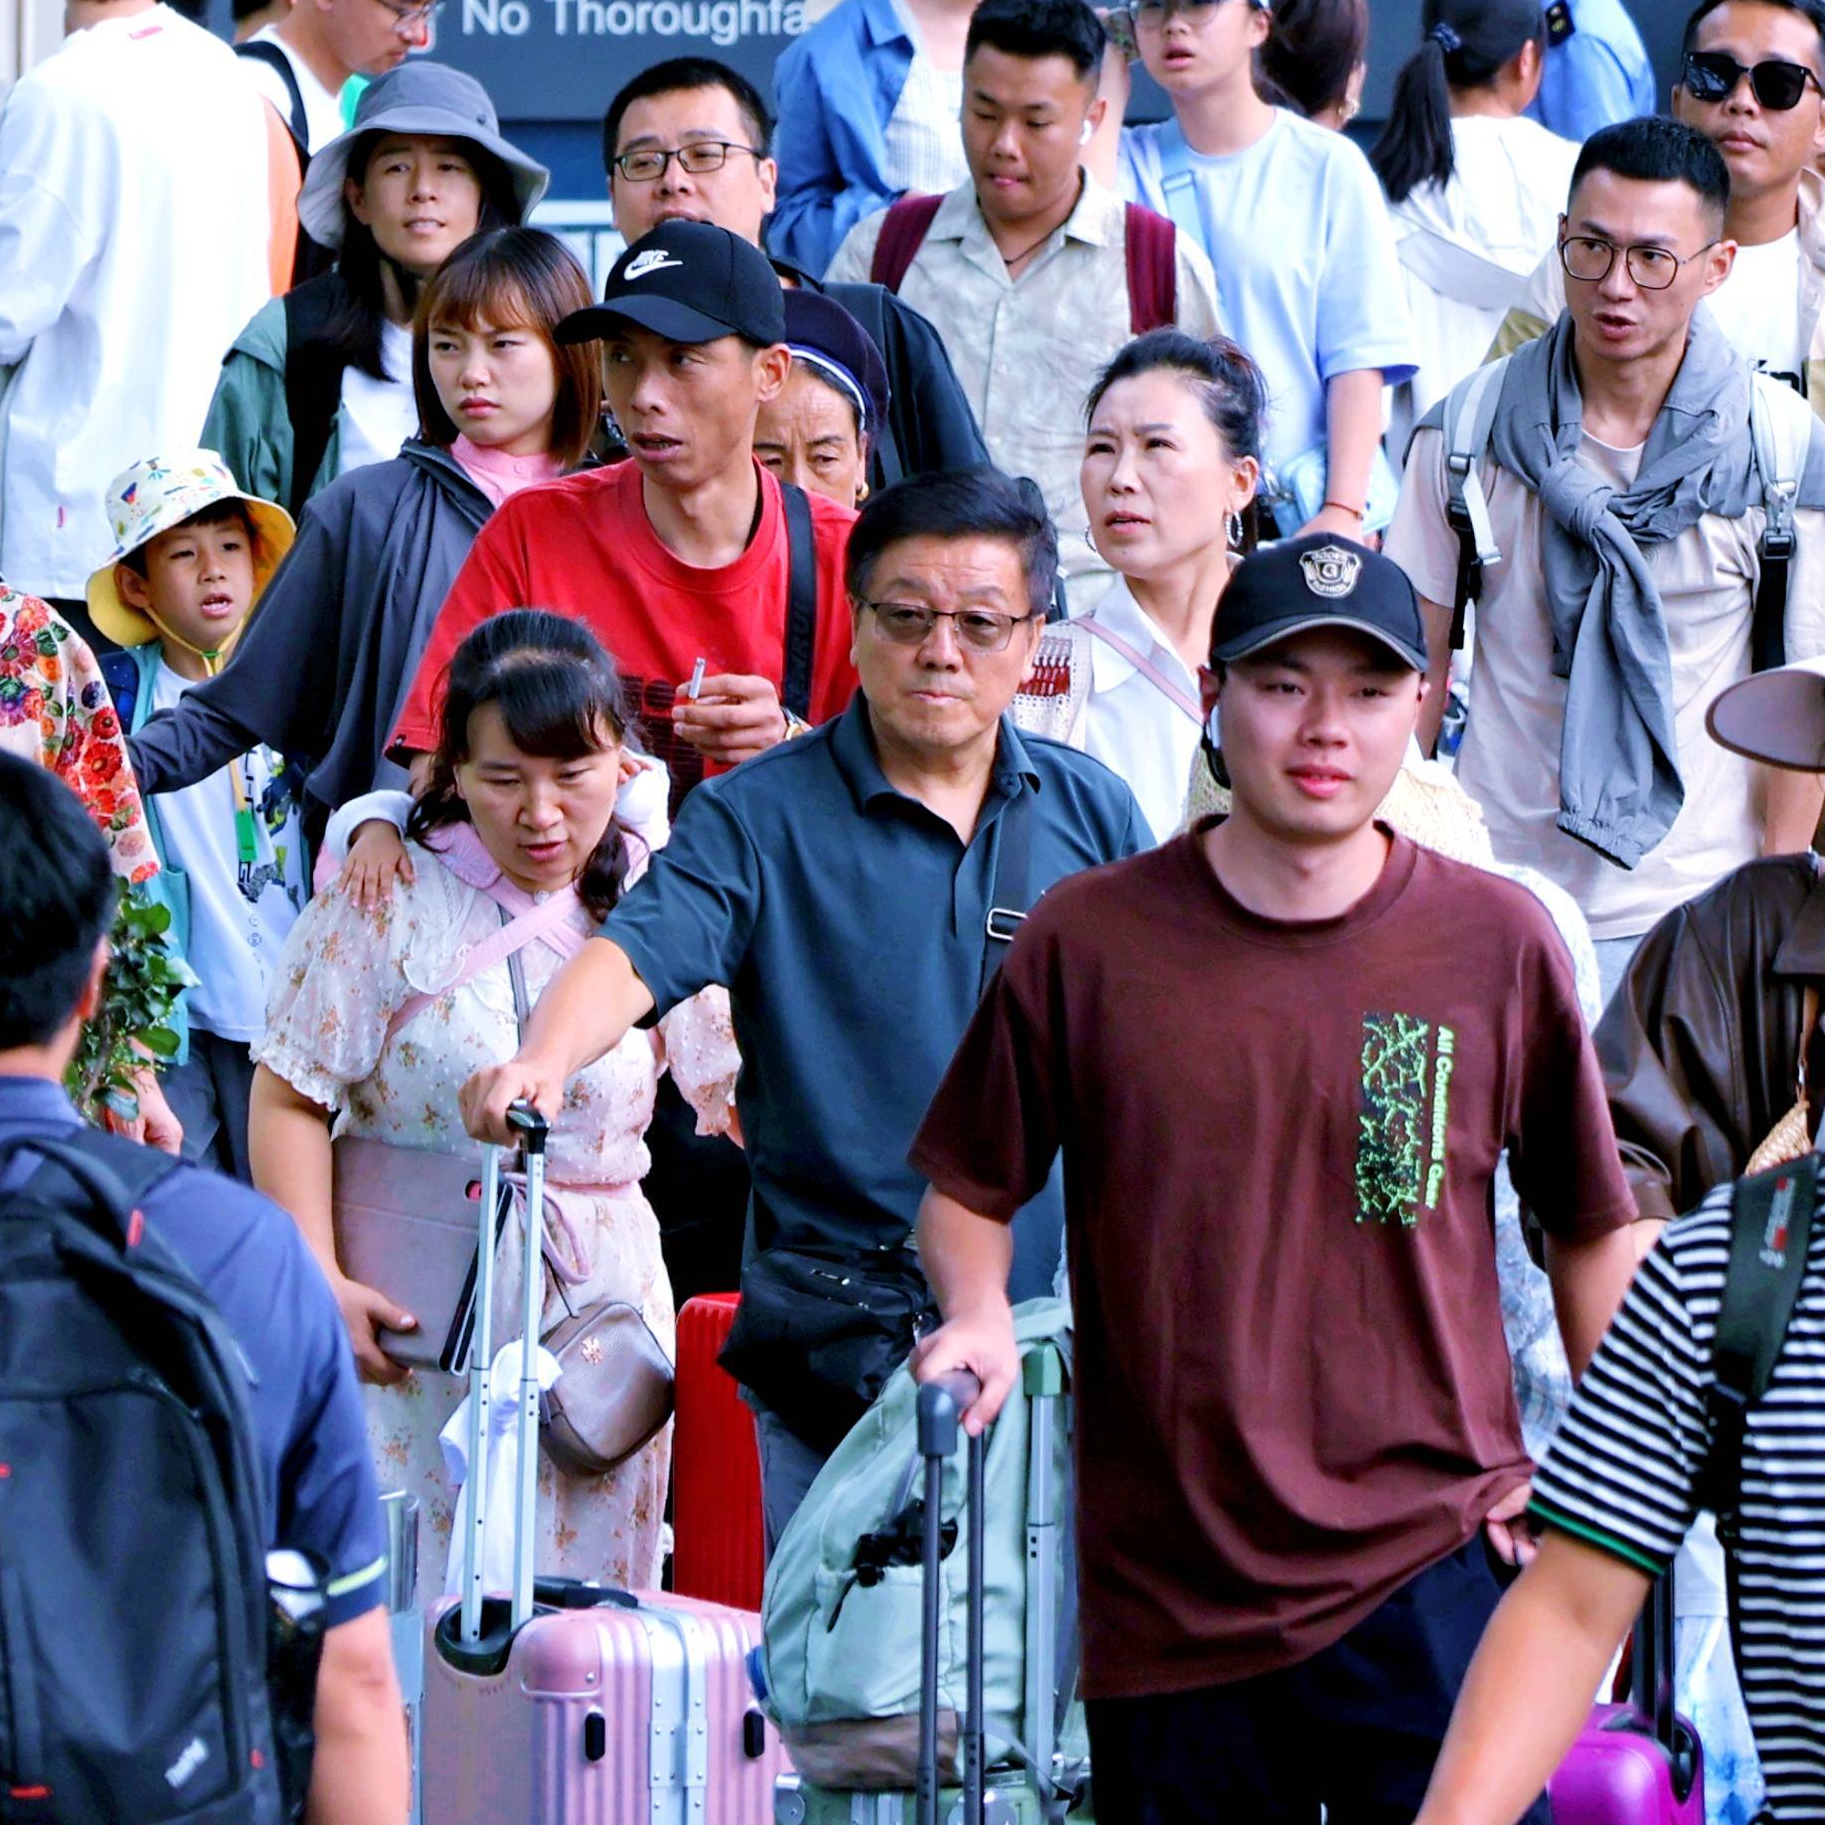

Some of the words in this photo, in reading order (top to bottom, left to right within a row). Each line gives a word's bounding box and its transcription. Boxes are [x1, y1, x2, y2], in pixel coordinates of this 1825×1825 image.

[1436, 1025, 1455, 1053] All
[1430, 1056, 1454, 1161] Conditions
[1424, 1163, 1447, 1210] Gear
